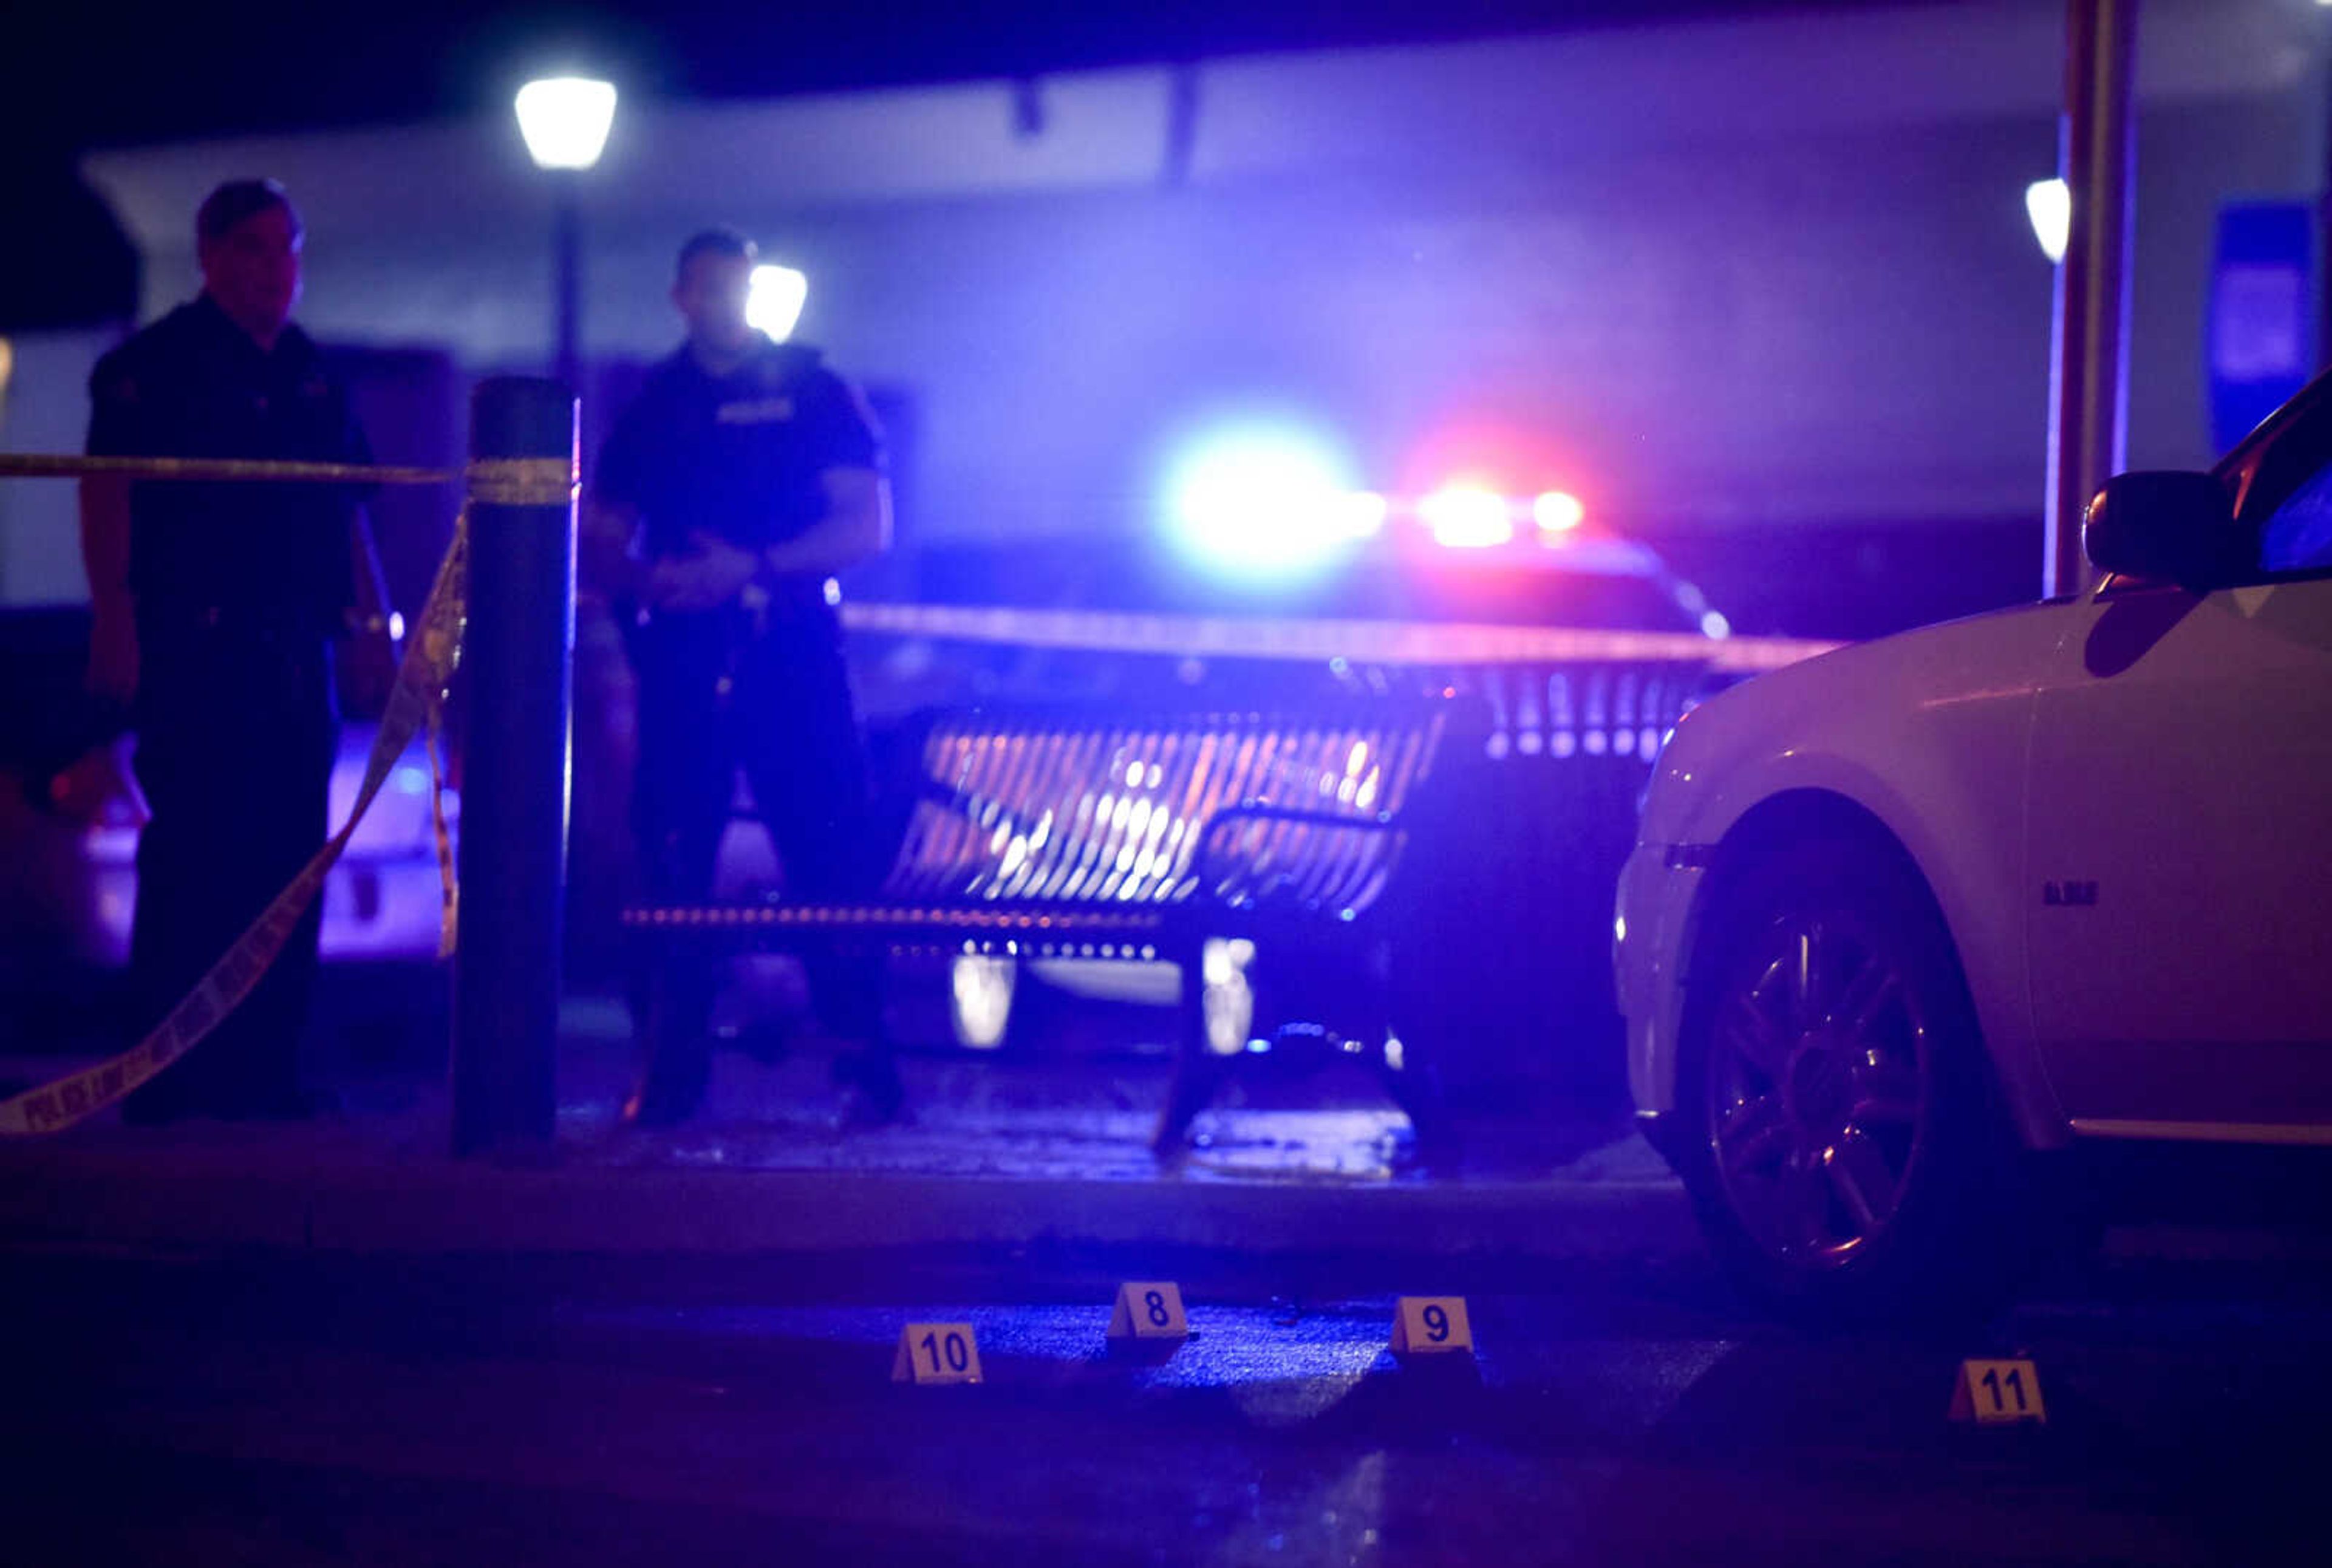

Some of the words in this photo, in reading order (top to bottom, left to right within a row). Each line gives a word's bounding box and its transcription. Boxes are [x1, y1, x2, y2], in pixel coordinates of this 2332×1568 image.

[1145, 1290, 1169, 1326] 8
[1423, 1305, 1449, 1341] 9
[921, 1332, 968, 1372] 10
[1982, 1368, 2027, 1411] 11
